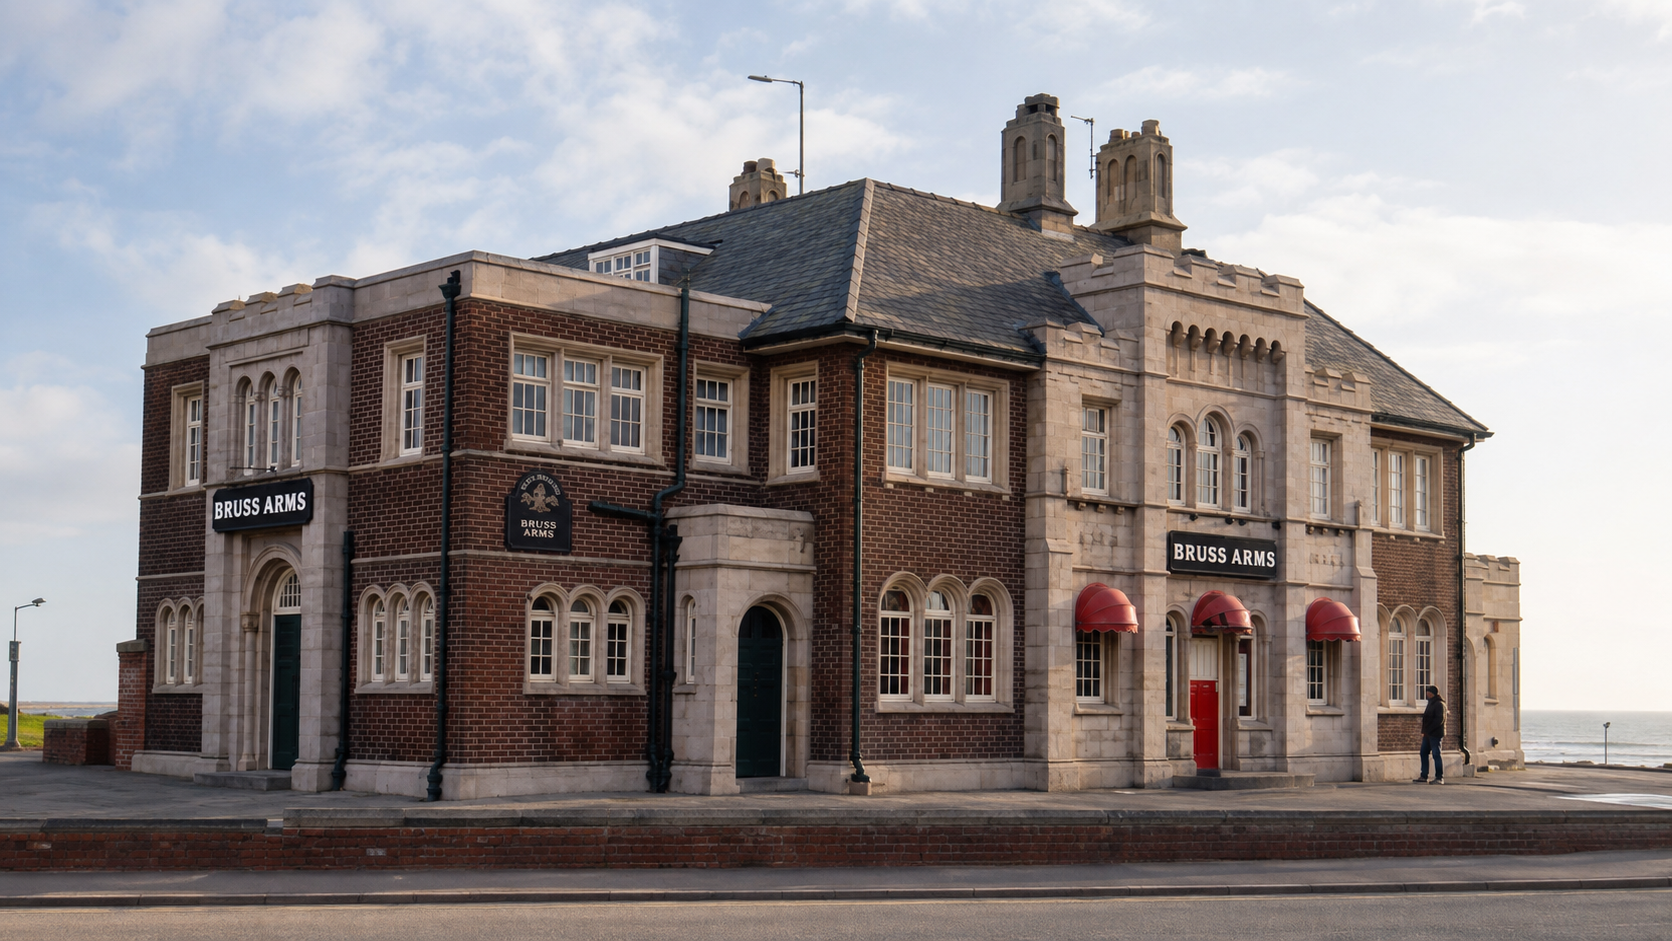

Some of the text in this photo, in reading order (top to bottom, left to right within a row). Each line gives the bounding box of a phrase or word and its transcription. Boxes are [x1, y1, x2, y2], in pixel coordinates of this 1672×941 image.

[214, 491, 306, 520] BRUSS ARMS
[521, 519, 557, 529] BRUSS
[523, 528, 554, 538] ARMS
[1173, 543, 1275, 568] BRUSS ARMS
